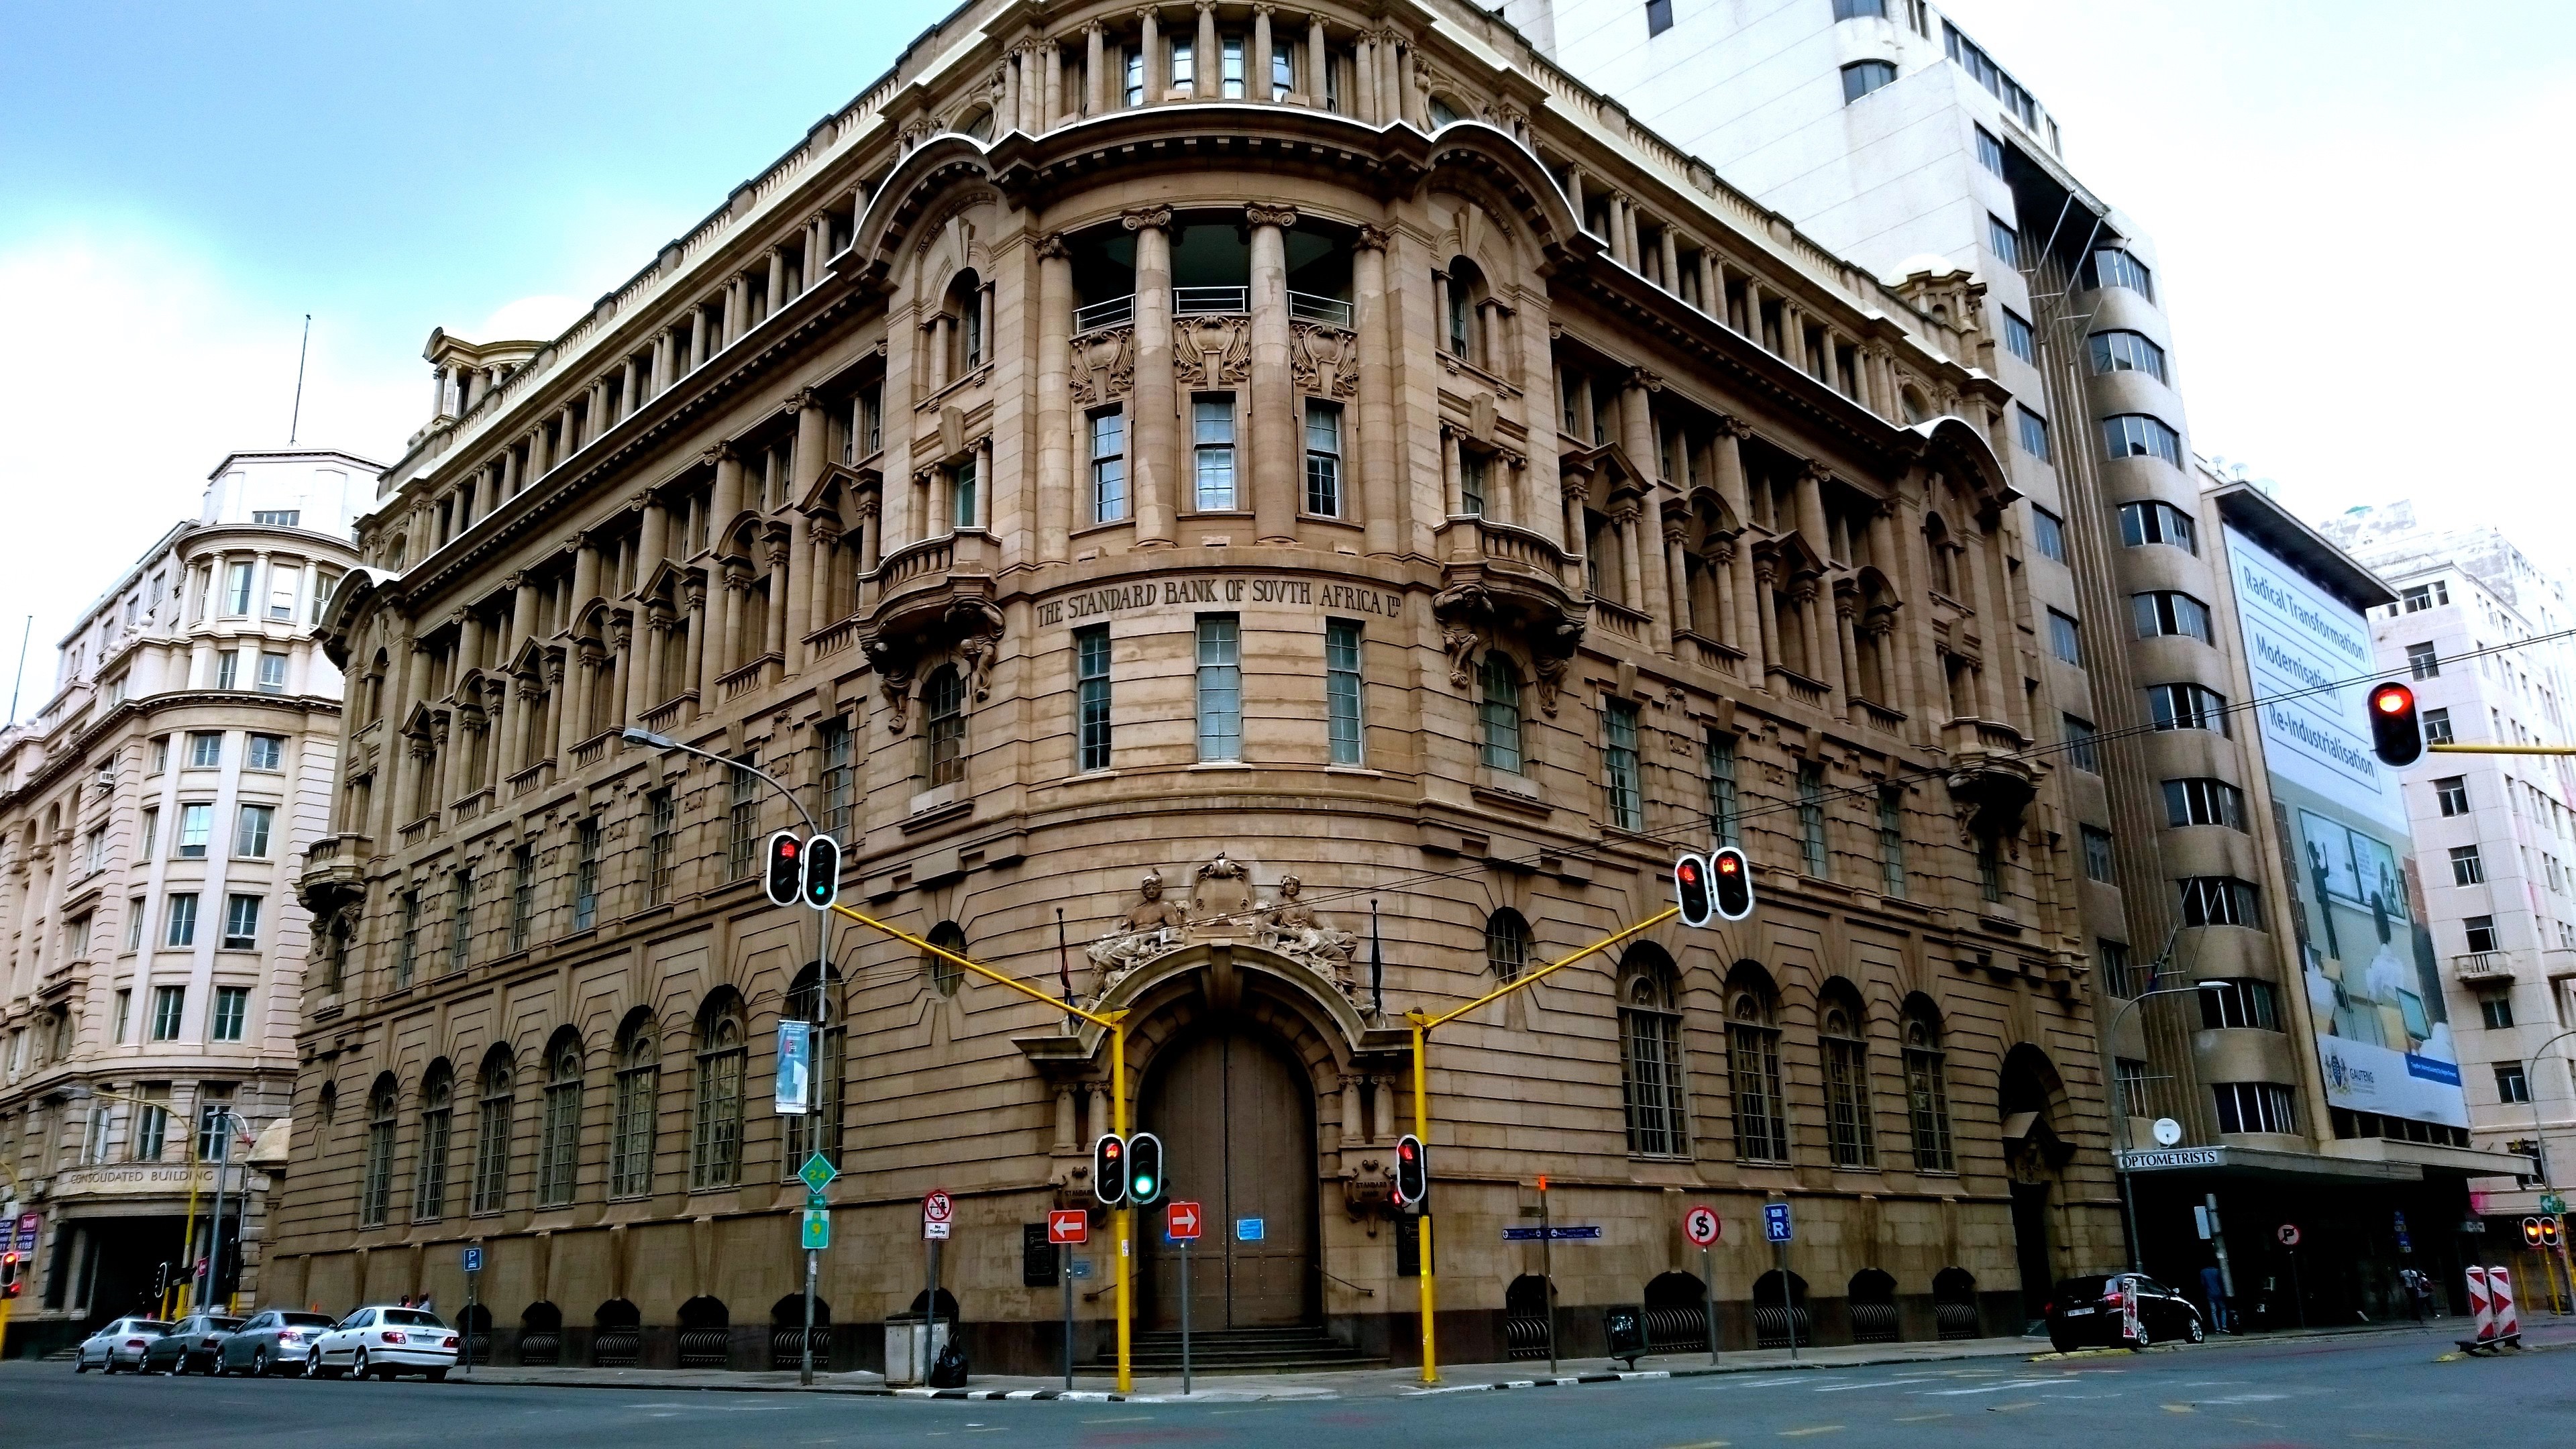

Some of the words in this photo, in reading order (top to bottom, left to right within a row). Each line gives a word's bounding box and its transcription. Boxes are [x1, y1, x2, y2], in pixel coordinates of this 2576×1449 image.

[1037, 603, 1063, 627] THE
[1068, 583, 1157, 619] STANDARD
[1164, 579, 1216, 605] BANK
[1226, 579, 1246, 602] OF
[1319, 584, 1383, 615] AFRICA
[2243, 565, 2288, 613] Radical
[2286, 594, 2366, 663] Transformation
[2255, 633, 2337, 700] Modernisation
[2267, 703, 2375, 778] Re-Industrialisation
[2349, 1068, 2374, 1083] GAUTENG
[2122, 1151, 2215, 1167] OPTOMETRISTS
[71, 1171, 144, 1184] CONSOLIDATED
[151, 1171, 214, 1181] BUILDING
[808, 1170, 826, 1180] 24
[1695, 1216, 1709, 1237] S
[1772, 1222, 1784, 1236] R
[2283, 1228, 2294, 1242] P
[468, 1250, 476, 1260] P
